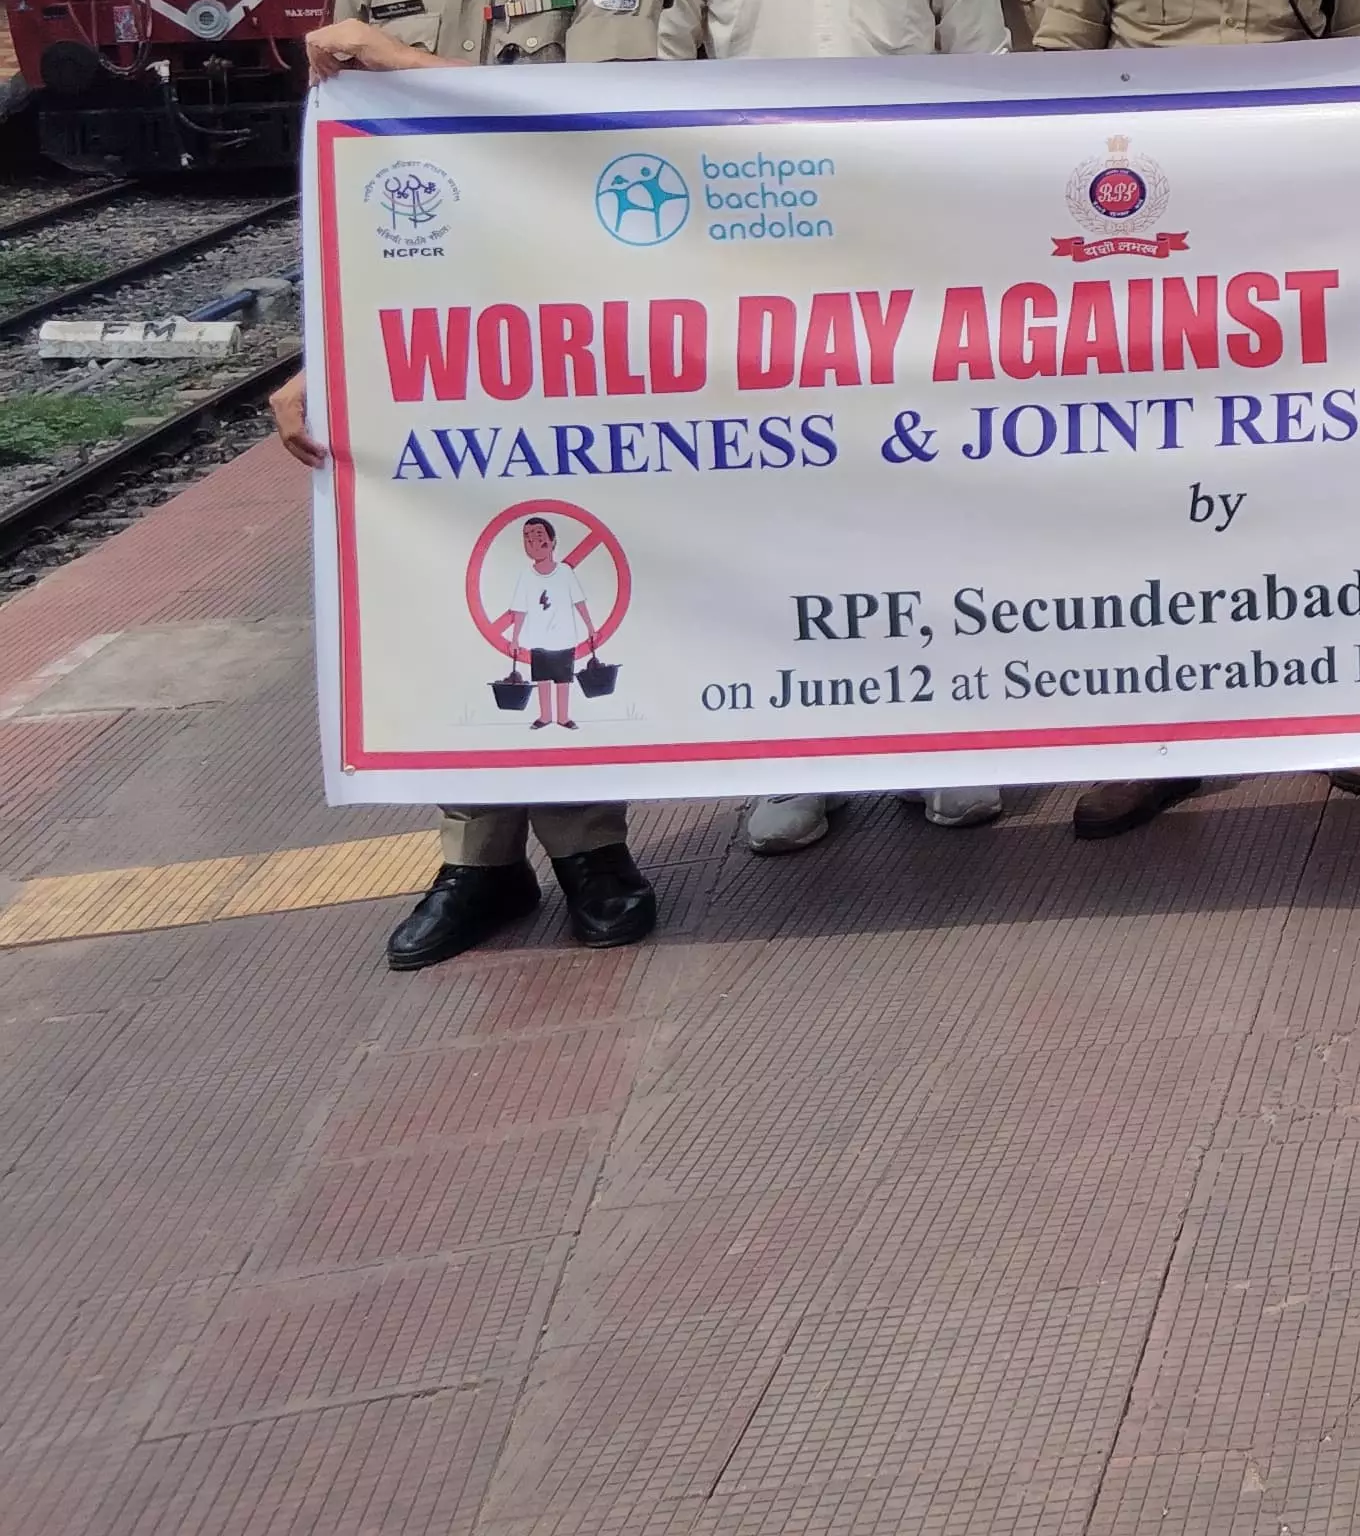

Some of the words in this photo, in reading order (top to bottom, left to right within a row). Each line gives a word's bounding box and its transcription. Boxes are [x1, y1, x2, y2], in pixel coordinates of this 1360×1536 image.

[702, 153, 834, 193] bachpan
[704, 183, 818, 210] bachao
[383, 247, 445, 259] NCPCR
[708, 214, 834, 241] andolan
[380, 300, 707, 402] WORLD
[737, 289, 913, 390] DAY
[932, 268, 1339, 381] AGAINST
[394, 414, 839, 480] AWARENESS
[881, 410, 937, 463] &
[962, 397, 1194, 460] JOINT
[1189, 481, 1247, 533] by
[792, 591, 933, 648] RPF,
[701, 683, 753, 711] on
[769, 665, 934, 709] June12
[951, 667, 989, 701] at
[1003, 645, 1338, 699] Secunderabad
